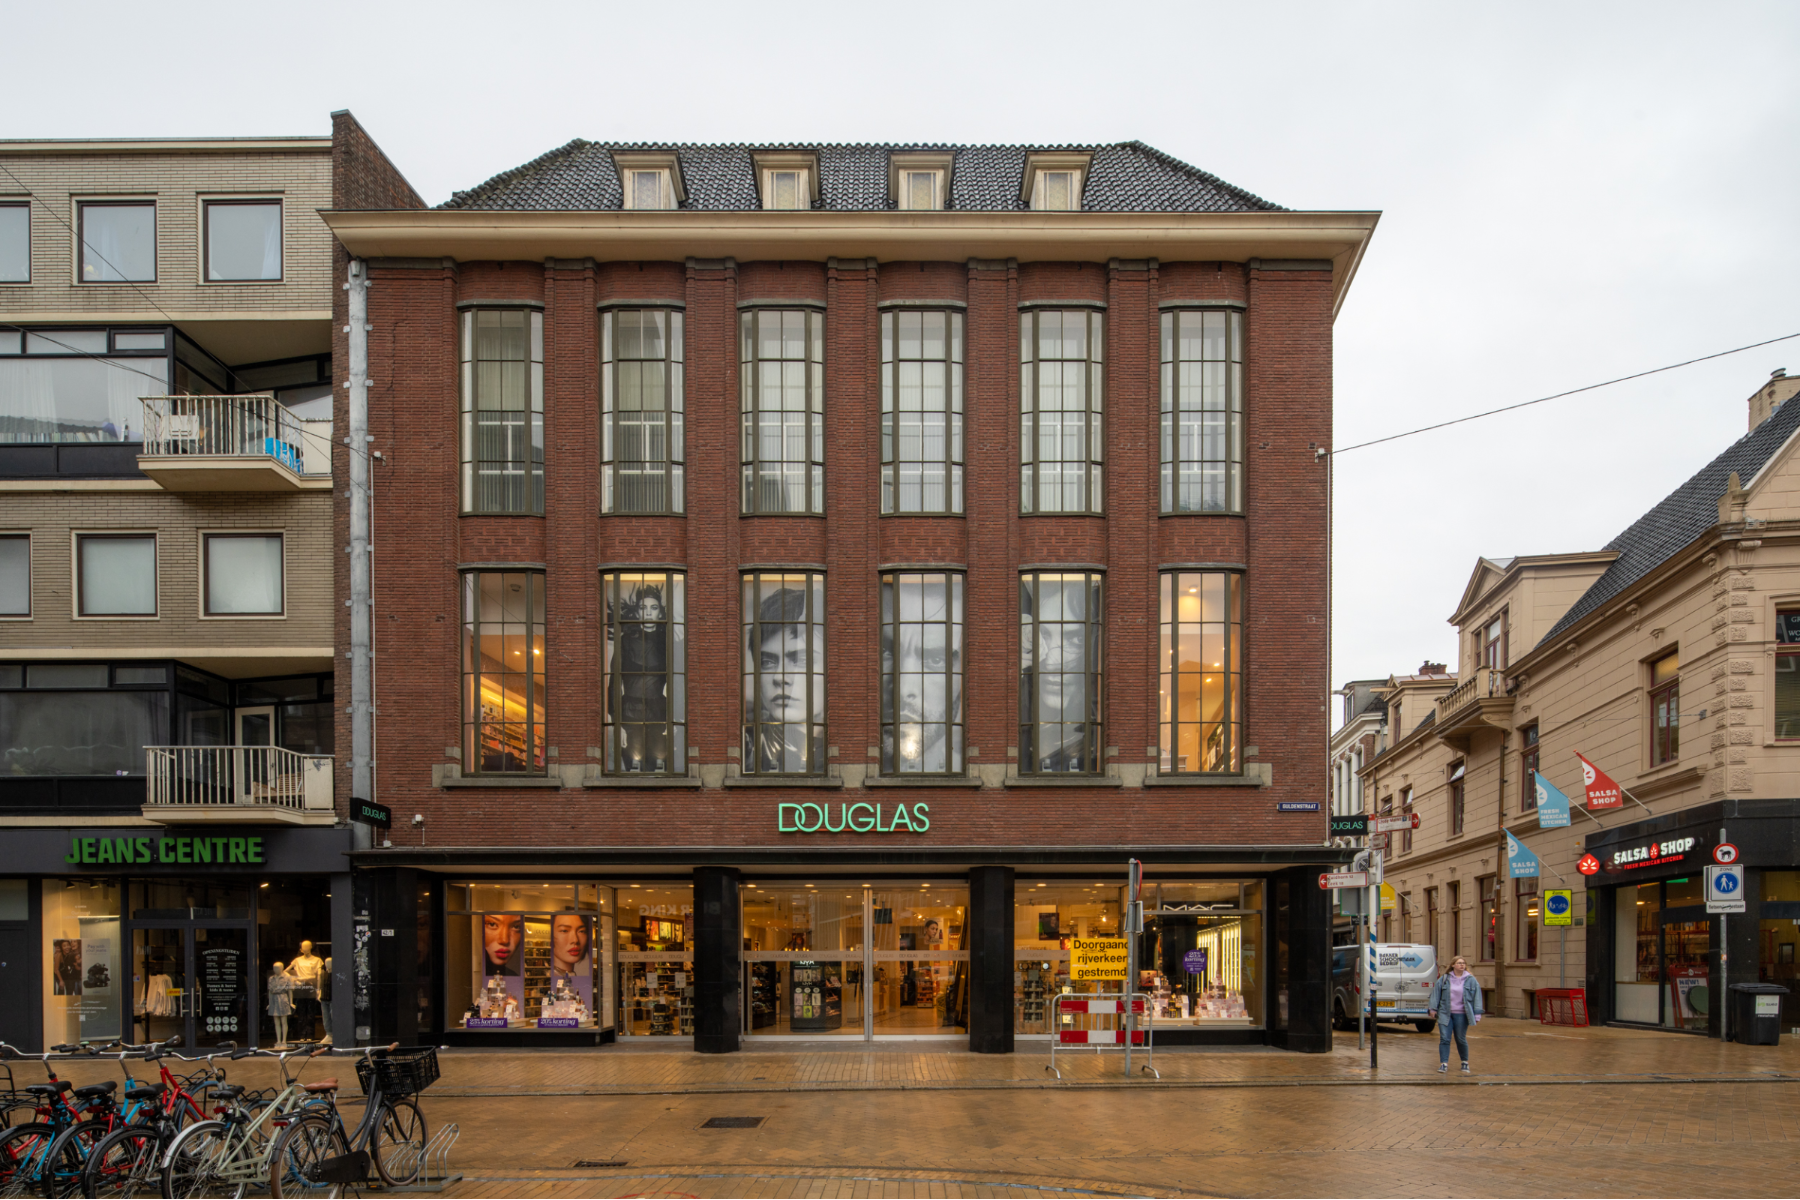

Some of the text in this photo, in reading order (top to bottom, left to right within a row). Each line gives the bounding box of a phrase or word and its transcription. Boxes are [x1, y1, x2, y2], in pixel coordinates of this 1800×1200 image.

[1589, 789, 1618, 798] SALSA
[362, 806, 386, 821] DOUGLAS
[778, 802, 930, 832] DOUGLAS
[1331, 821, 1364, 830] OUGLAS
[64, 837, 264, 864] JEANS CENTRE
[1614, 837, 1695, 864] SALSA SHOP
[1639, 859, 1660, 868] MEXICAN
[1662, 854, 1684, 863] KITCHEN
[1078, 954, 1127, 964] rijverkeer
[1078, 967, 1127, 978] gestremd
